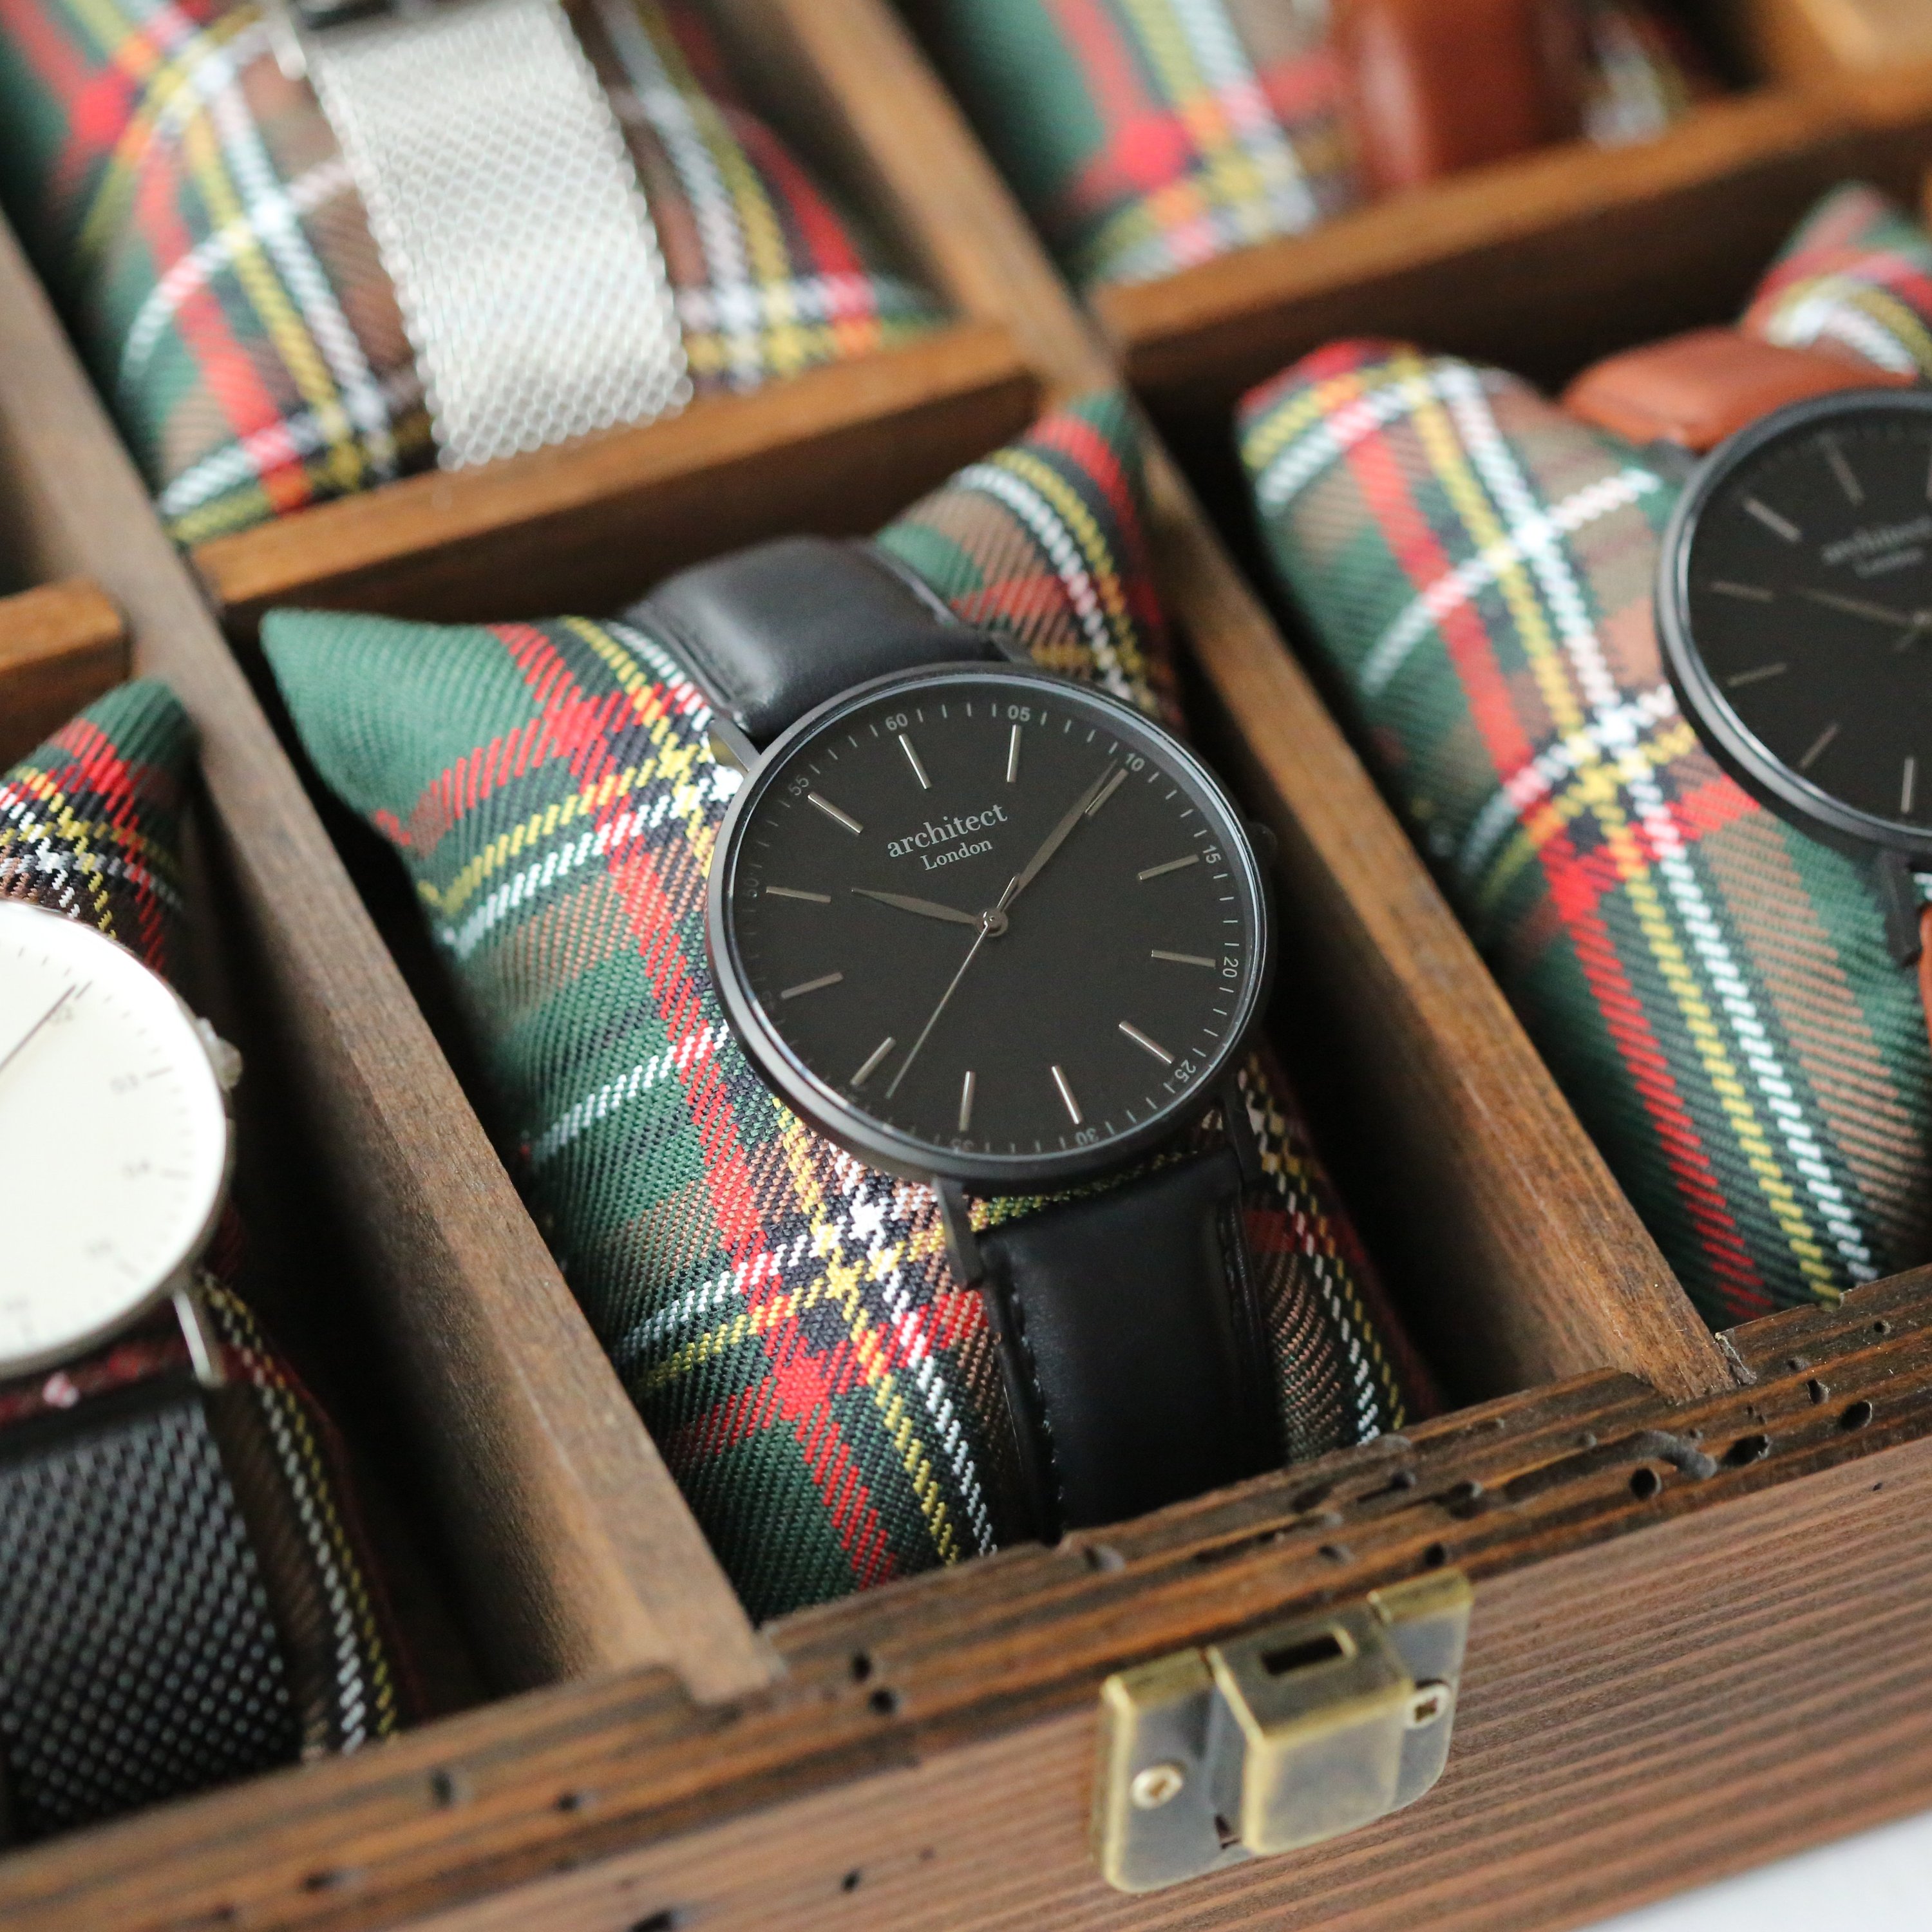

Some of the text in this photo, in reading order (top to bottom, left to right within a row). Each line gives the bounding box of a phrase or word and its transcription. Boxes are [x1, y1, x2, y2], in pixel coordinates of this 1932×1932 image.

[885, 713, 908, 731] 60
[1007, 705, 1030, 722] 05
[1126, 753, 1145, 772] 10
[788, 774, 809, 796] 55
[887, 804, 1008, 858] architect
[920, 839, 994, 871] London
[1202, 844, 1222, 864] 15
[1222, 956, 1239, 978] 20
[1174, 1059, 1197, 1083] 25
[1075, 1128, 1099, 1146] 30
